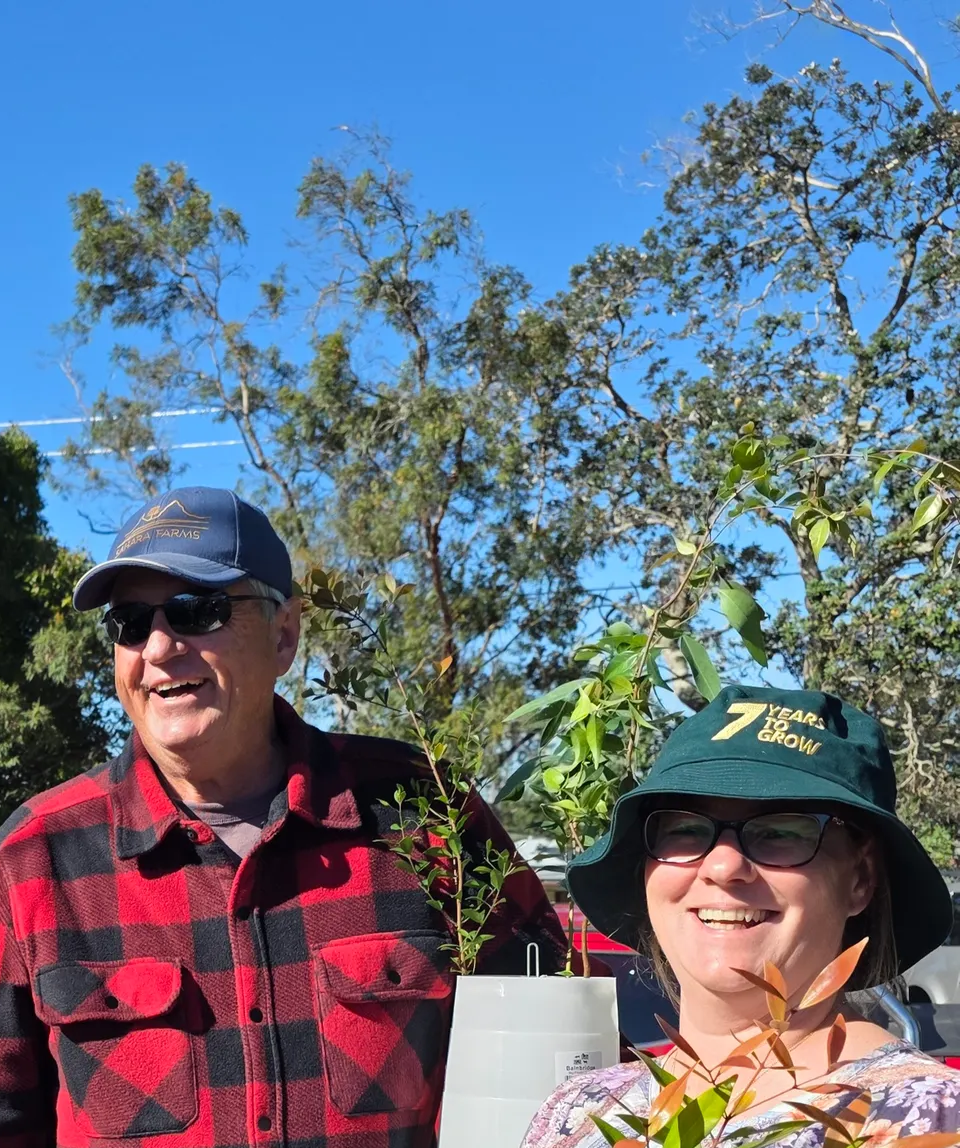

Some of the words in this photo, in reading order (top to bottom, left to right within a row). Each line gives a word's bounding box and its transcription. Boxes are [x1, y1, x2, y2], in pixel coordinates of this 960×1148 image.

[156, 528, 200, 540] FARMS
[711, 702, 768, 741] 7
[763, 716, 790, 732] TO
[765, 704, 826, 730] YEARS
[757, 729, 822, 756] GROW
